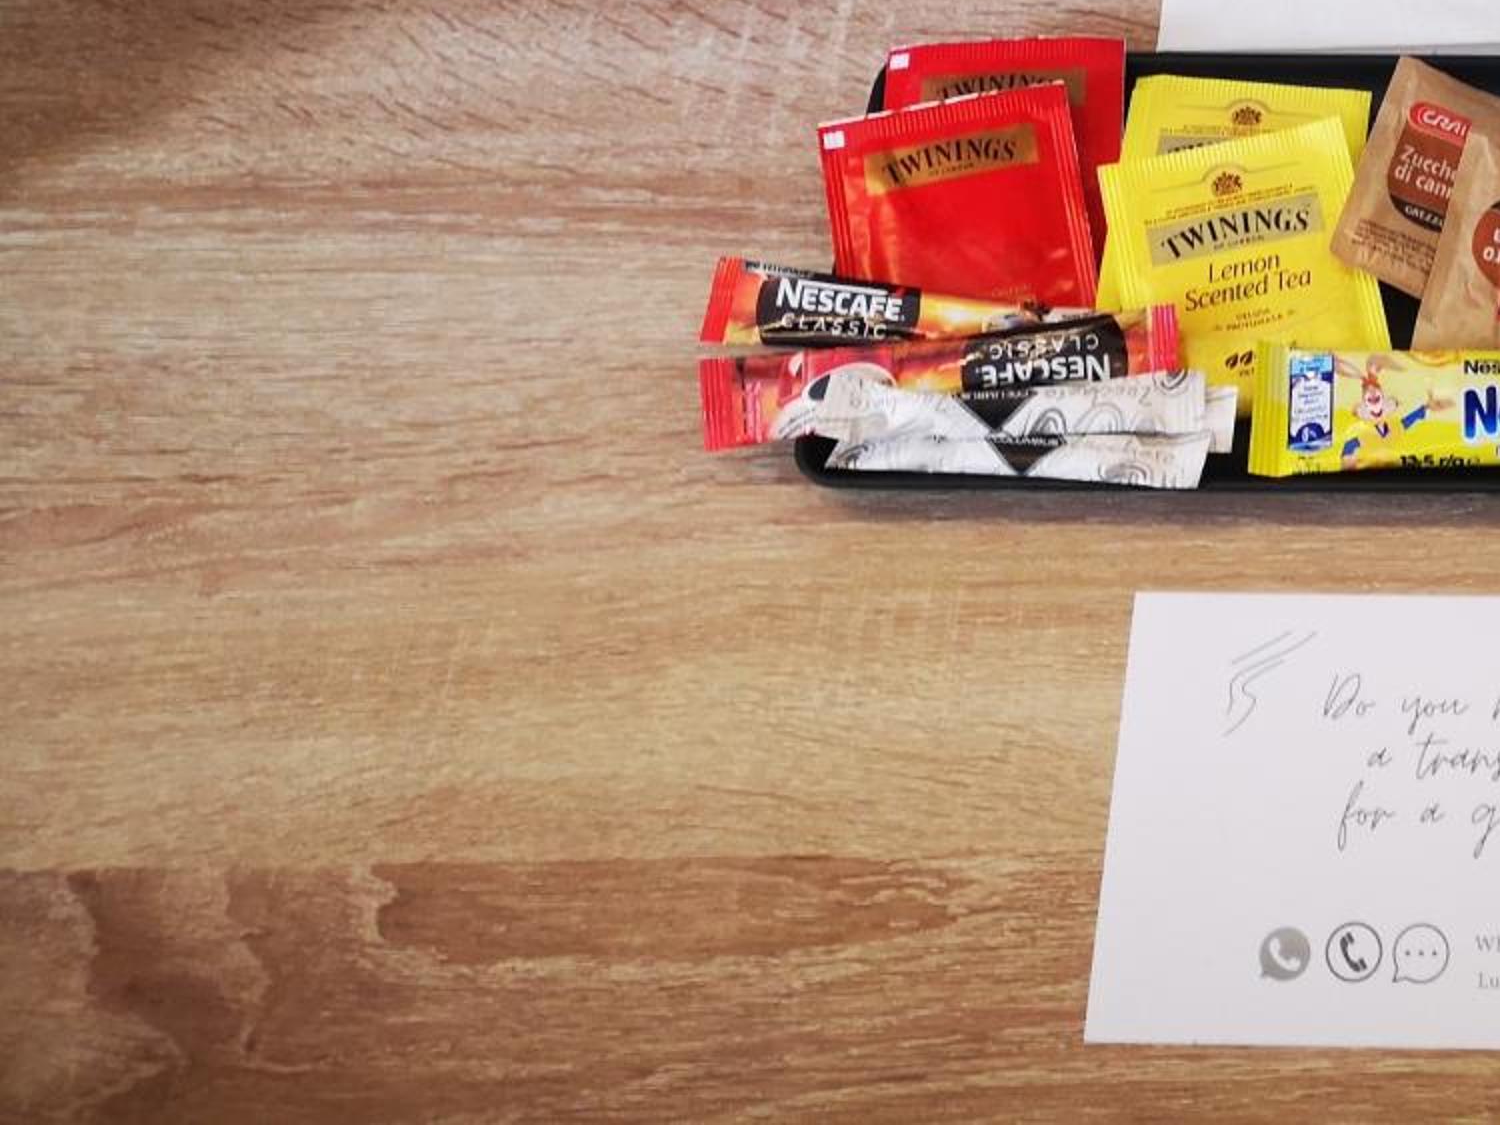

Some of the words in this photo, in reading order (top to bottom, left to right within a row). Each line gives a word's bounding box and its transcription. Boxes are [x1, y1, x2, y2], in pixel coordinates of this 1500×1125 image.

[882, 138, 1017, 186] TWININGS
[1394, 161, 1414, 184] di
[1161, 207, 1312, 259] TWININGS
[1208, 254, 1281, 284] Lemon
[1185, 276, 1268, 312] Scented
[1278, 270, 1312, 291] Tea
[782, 312, 888, 340] CLASSIC
[990, 332, 1099, 360] CLASSIC
[1324, 673, 1376, 720] Do
[1400, 696, 1469, 735] you
[1367, 747, 1392, 767] a
[1337, 780, 1395, 852] for
[1420, 803, 1445, 824] a
